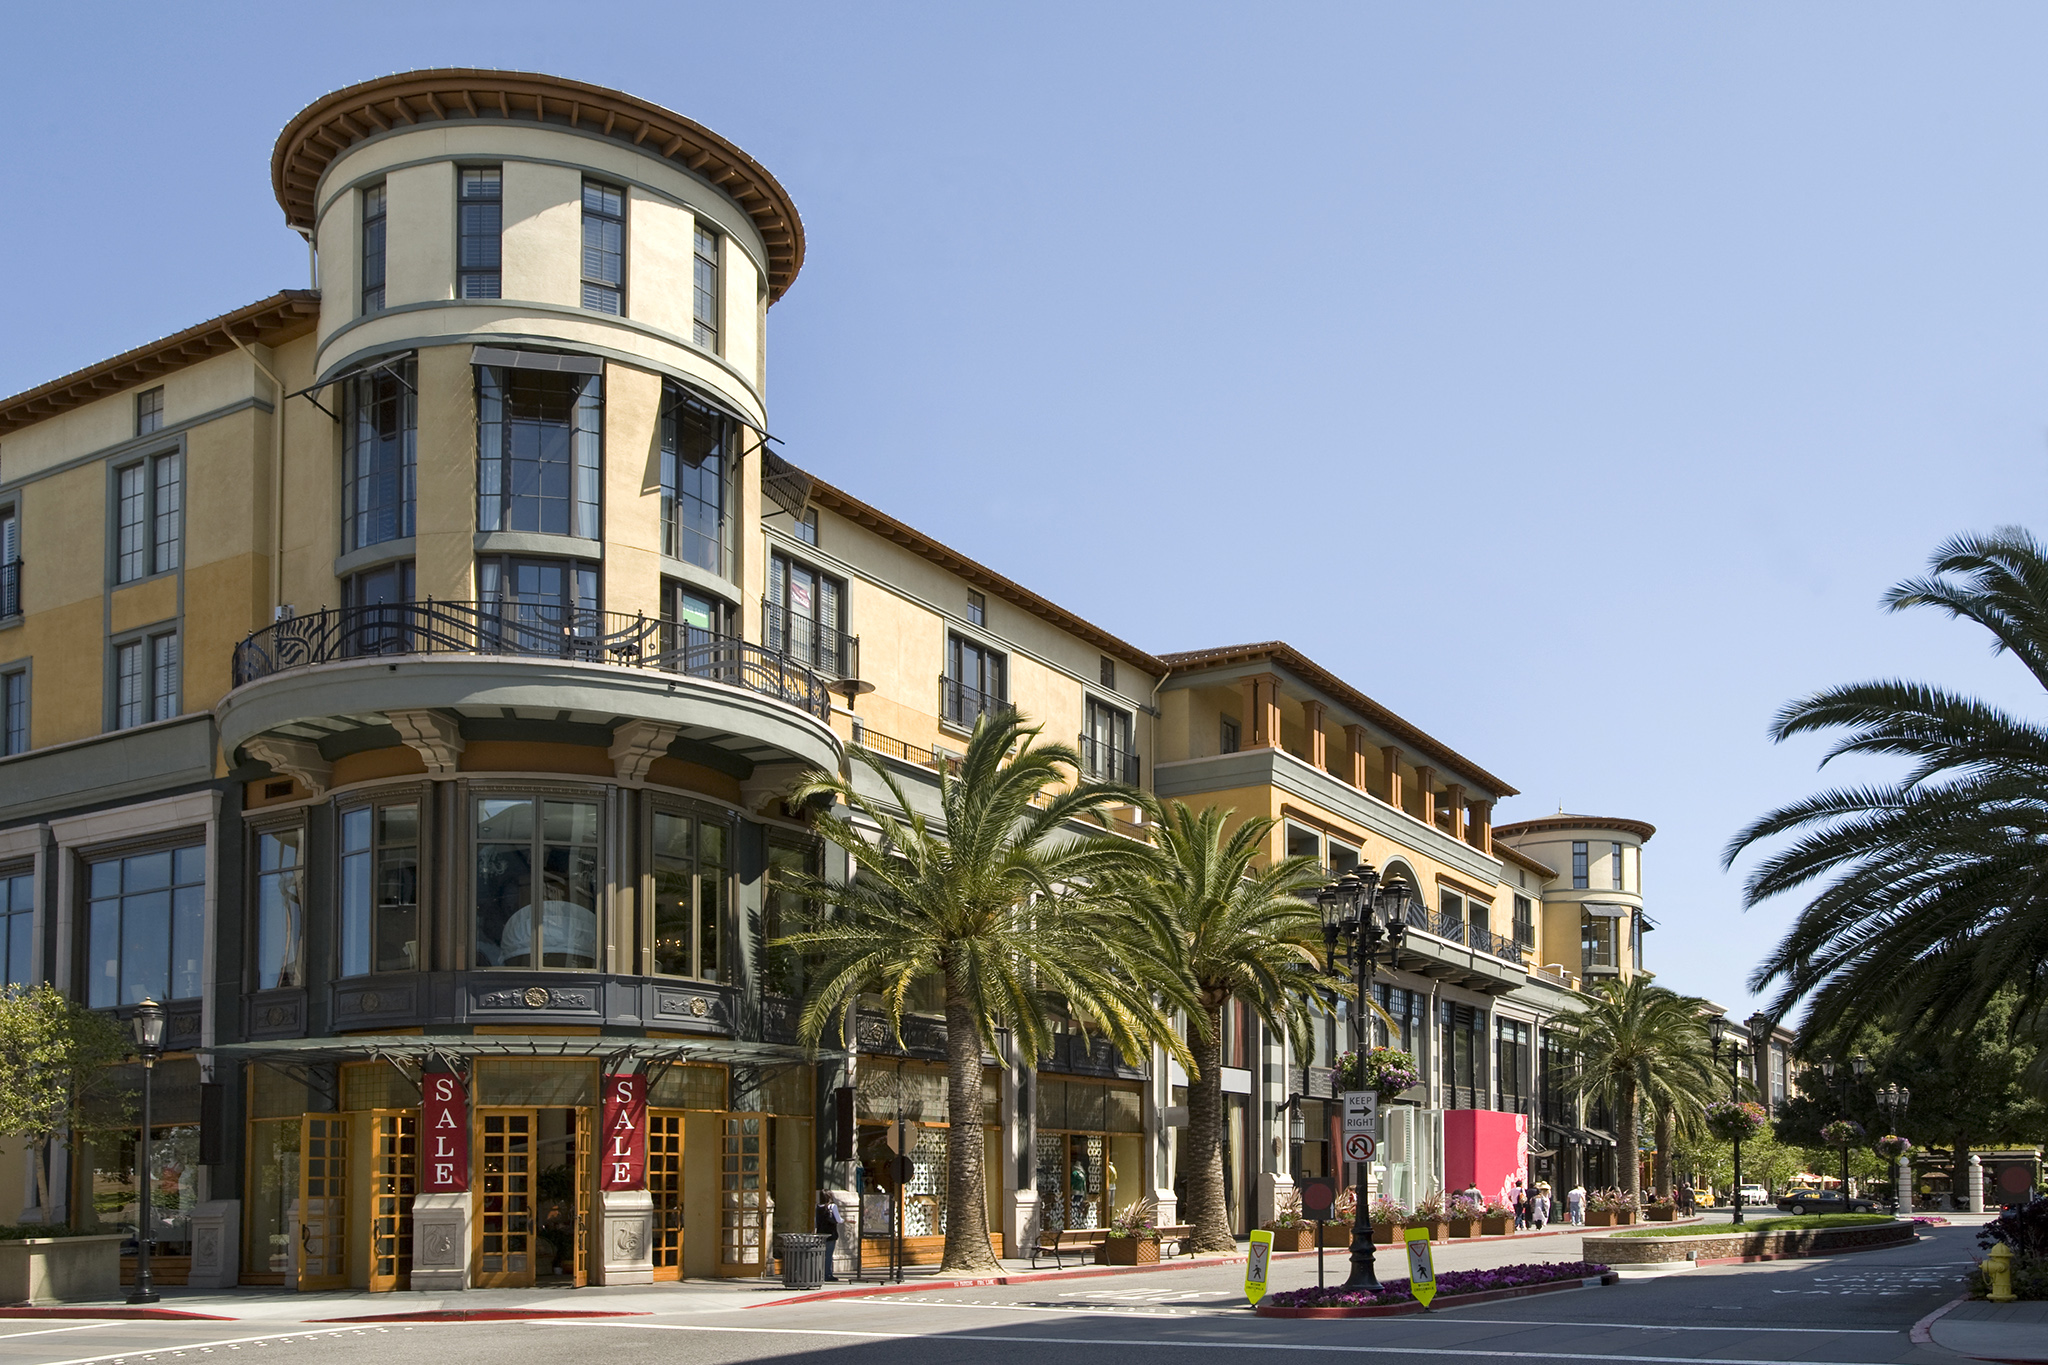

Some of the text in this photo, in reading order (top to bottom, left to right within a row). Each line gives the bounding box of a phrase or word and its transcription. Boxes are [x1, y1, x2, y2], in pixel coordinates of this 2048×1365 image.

[1347, 1118, 1374, 1127] RIGHT
[1349, 1096, 1372, 1105] KEEP
[434, 1078, 457, 1184] SALE
[612, 1081, 635, 1183] SALE
